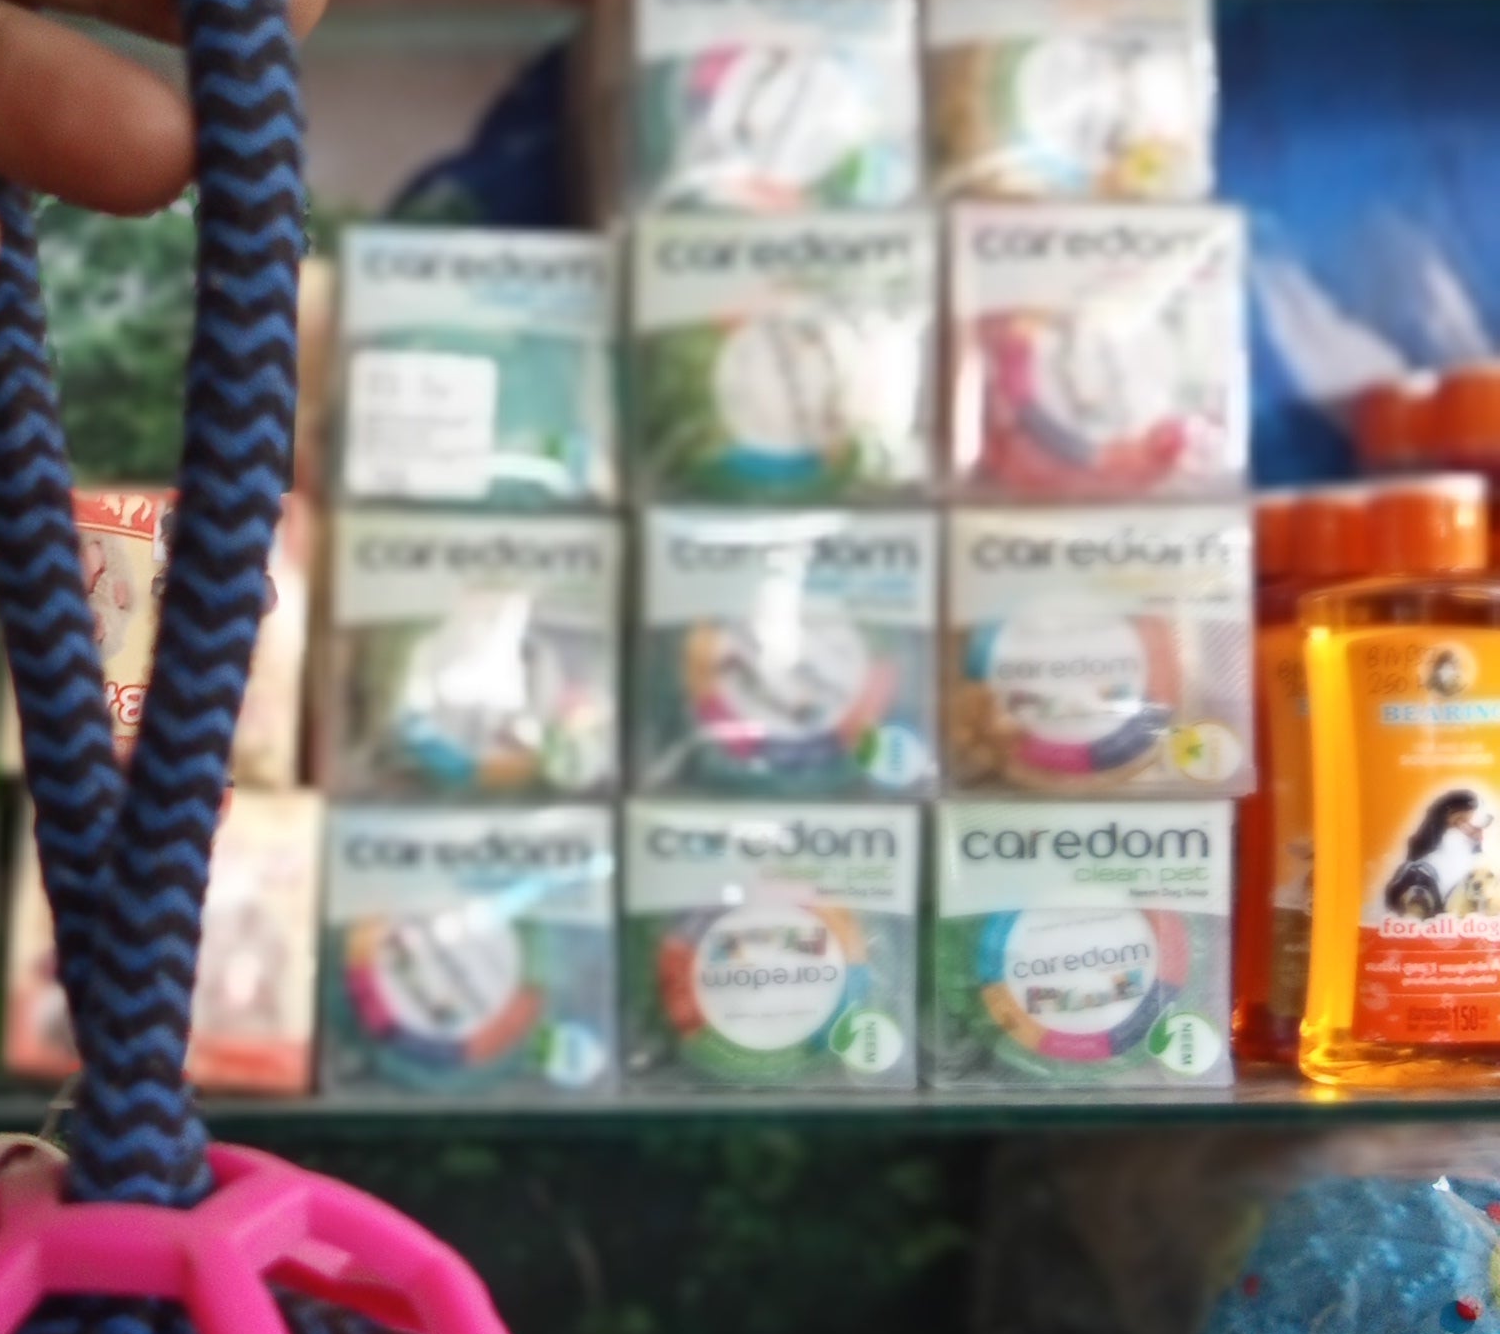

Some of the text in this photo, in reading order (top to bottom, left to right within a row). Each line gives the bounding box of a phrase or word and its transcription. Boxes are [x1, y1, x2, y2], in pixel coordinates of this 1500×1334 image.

[961, 822, 1210, 861] caredom
[1073, 866, 1210, 885] clean pet
[1383, 917, 1418, 935] for
[1426, 918, 1454, 935] all
[701, 964, 839, 990] caredom
[1013, 942, 1151, 980] caredom
[863, 1019, 878, 1064] NEEM
[1181, 1021, 1194, 1066] NEEM
